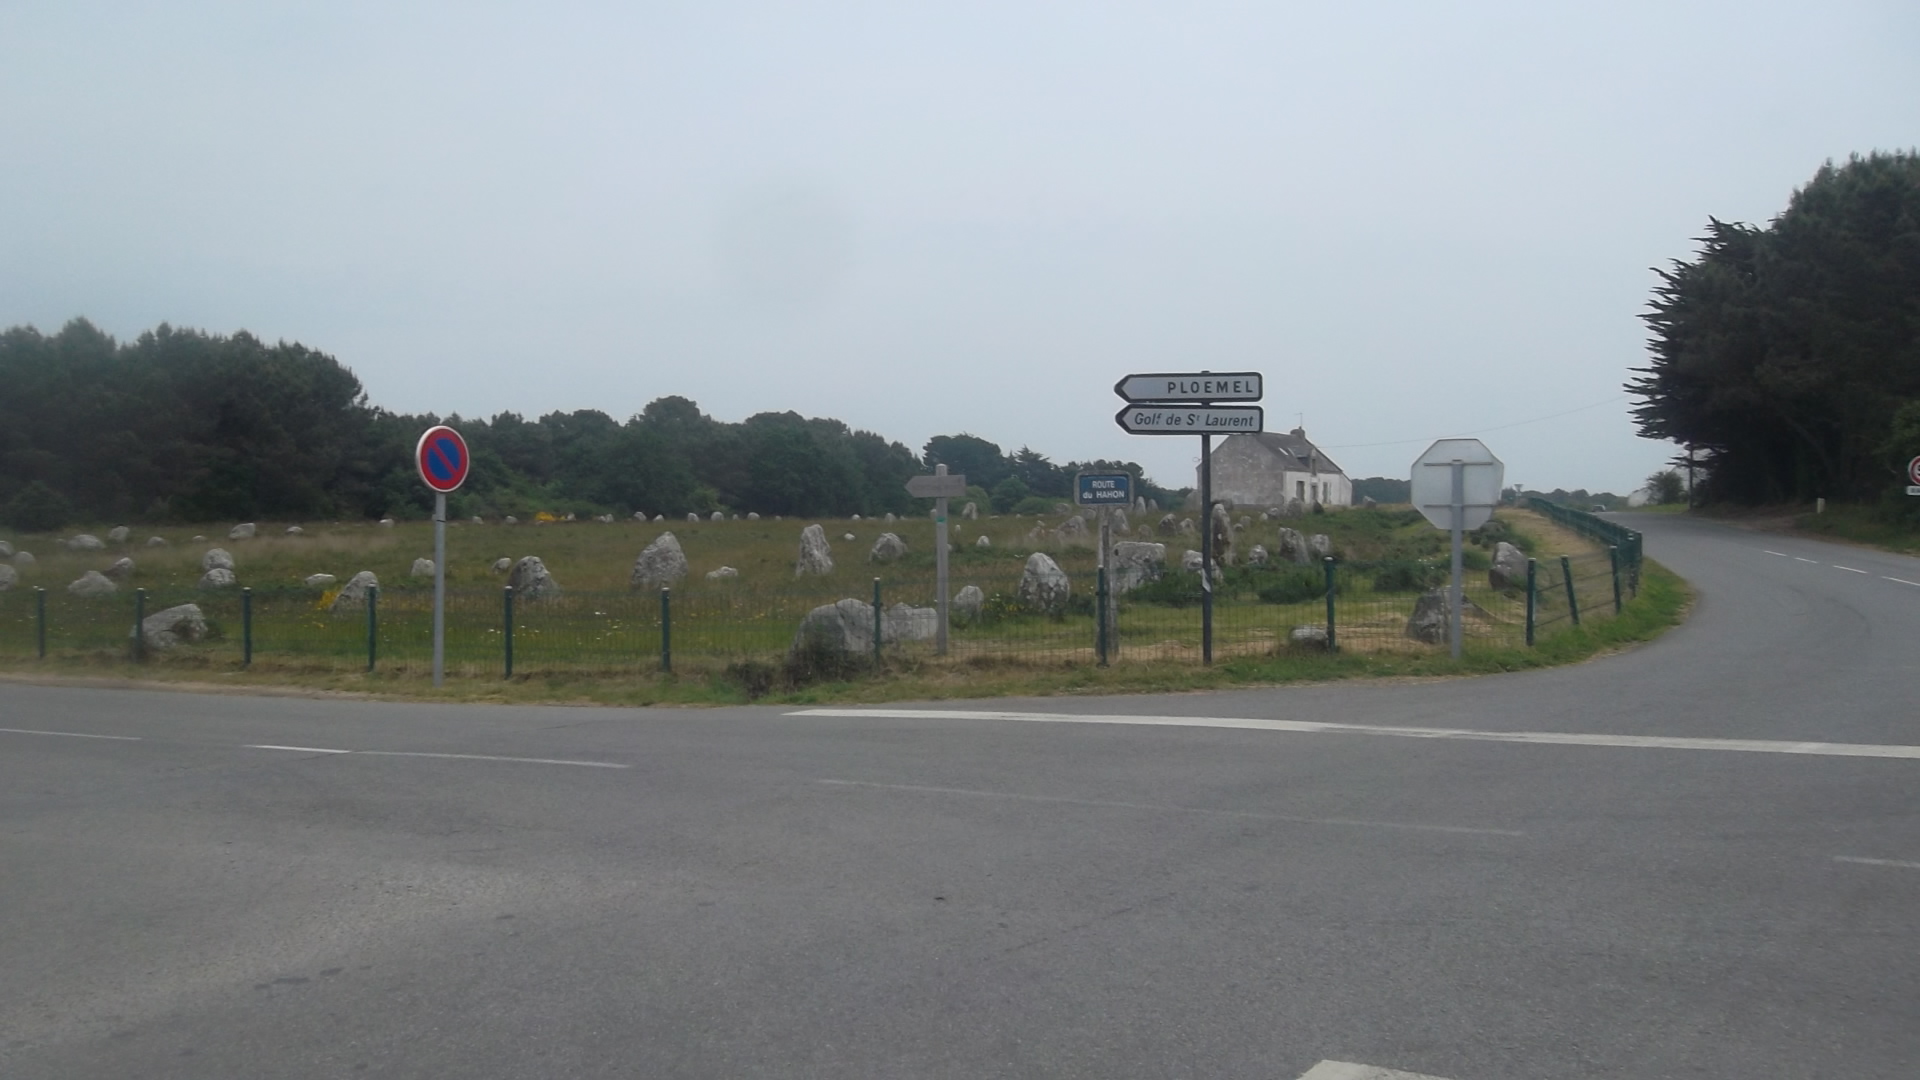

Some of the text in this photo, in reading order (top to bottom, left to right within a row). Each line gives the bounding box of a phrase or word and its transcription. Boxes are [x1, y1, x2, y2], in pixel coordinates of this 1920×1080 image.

[1167, 380, 1253, 394] PLOEMEL
[1134, 412, 1254, 427] Golf de St Laurent
[1091, 480, 1115, 489] ROUTE
[1082, 490, 1125, 499] du HAHON
